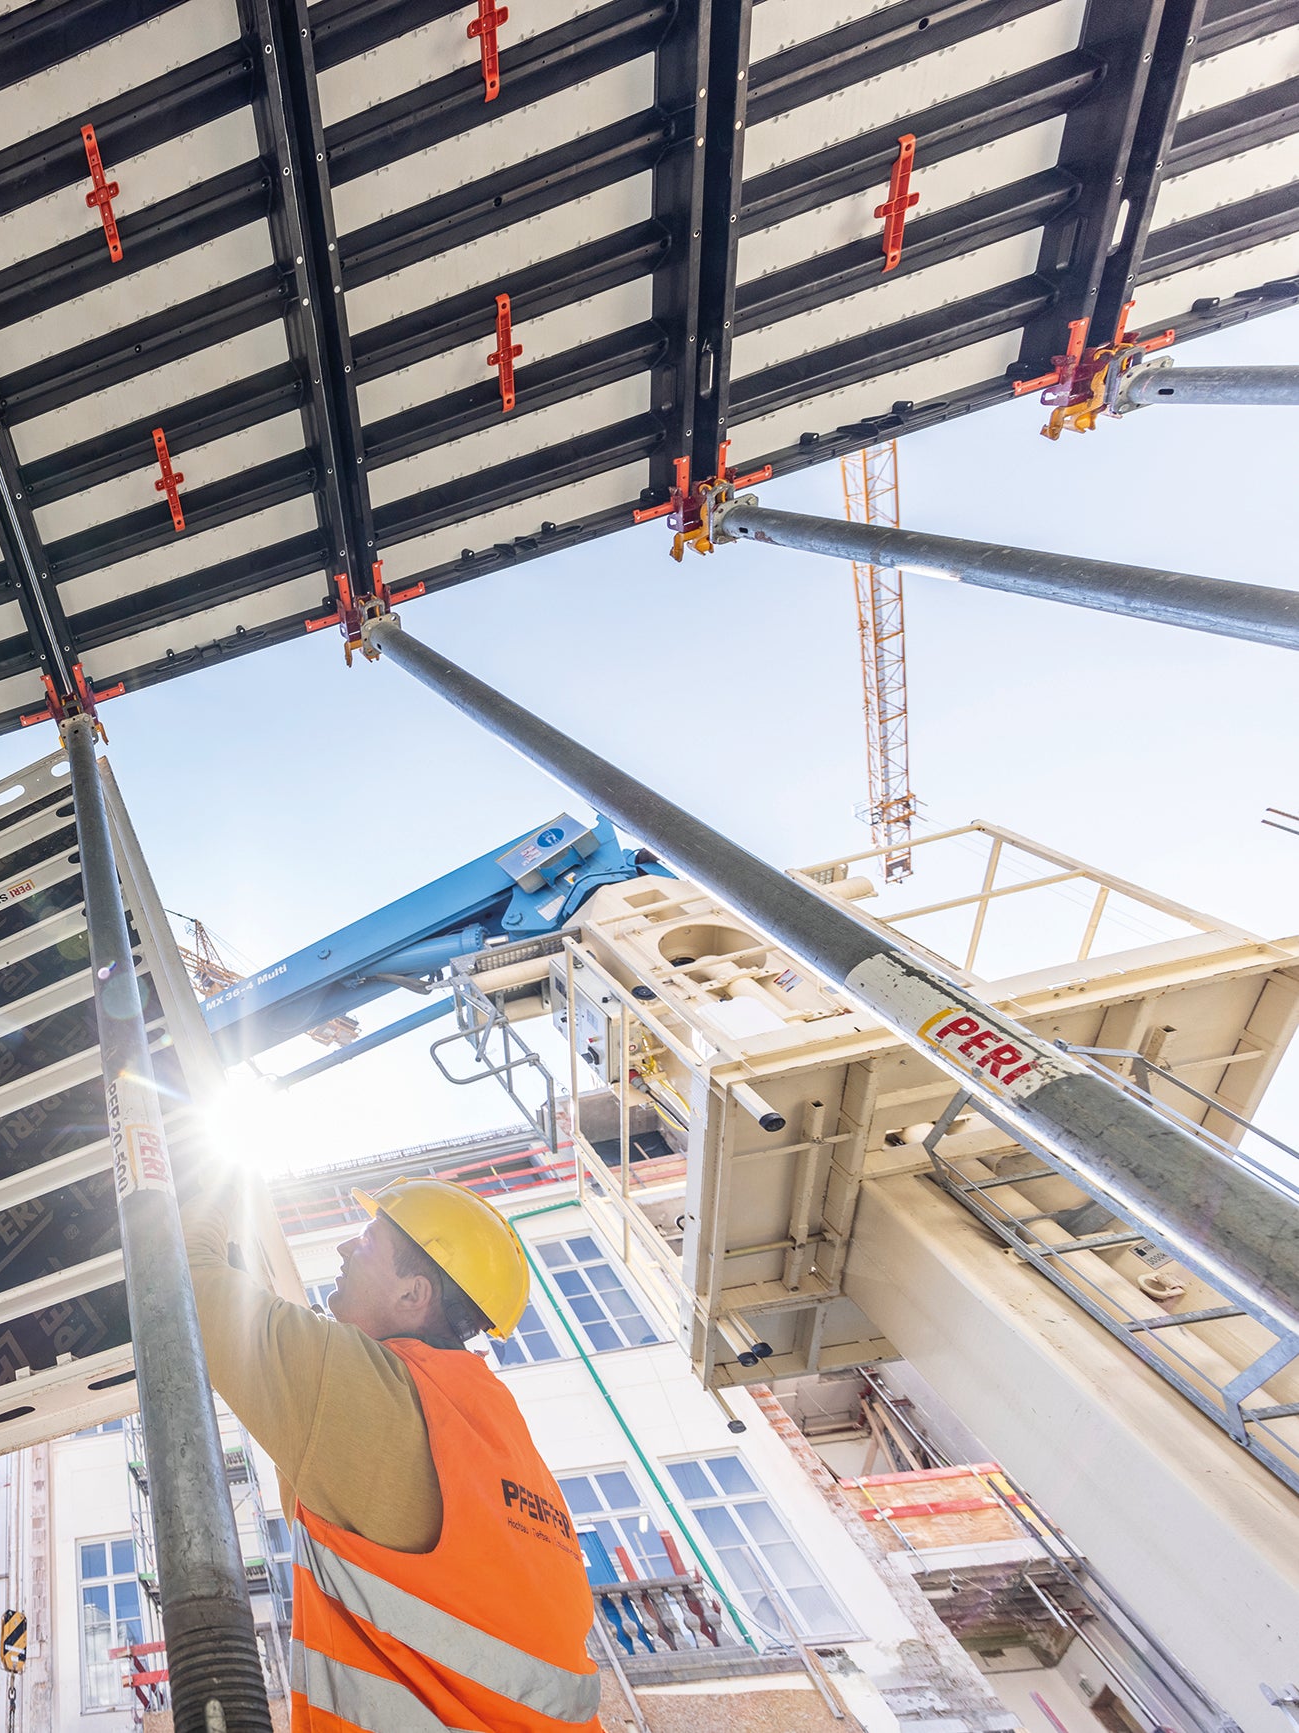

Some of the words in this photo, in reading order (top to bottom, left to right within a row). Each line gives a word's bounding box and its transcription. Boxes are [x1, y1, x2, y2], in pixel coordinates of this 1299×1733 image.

[9, 882, 32, 898] PERI
[206, 996, 224, 1012] MX
[225, 981, 254, 1001] 36-4
[257, 963, 288, 986] Multi
[935, 1016, 1038, 1086] PERI
[137, 1131, 169, 1184] PERI
